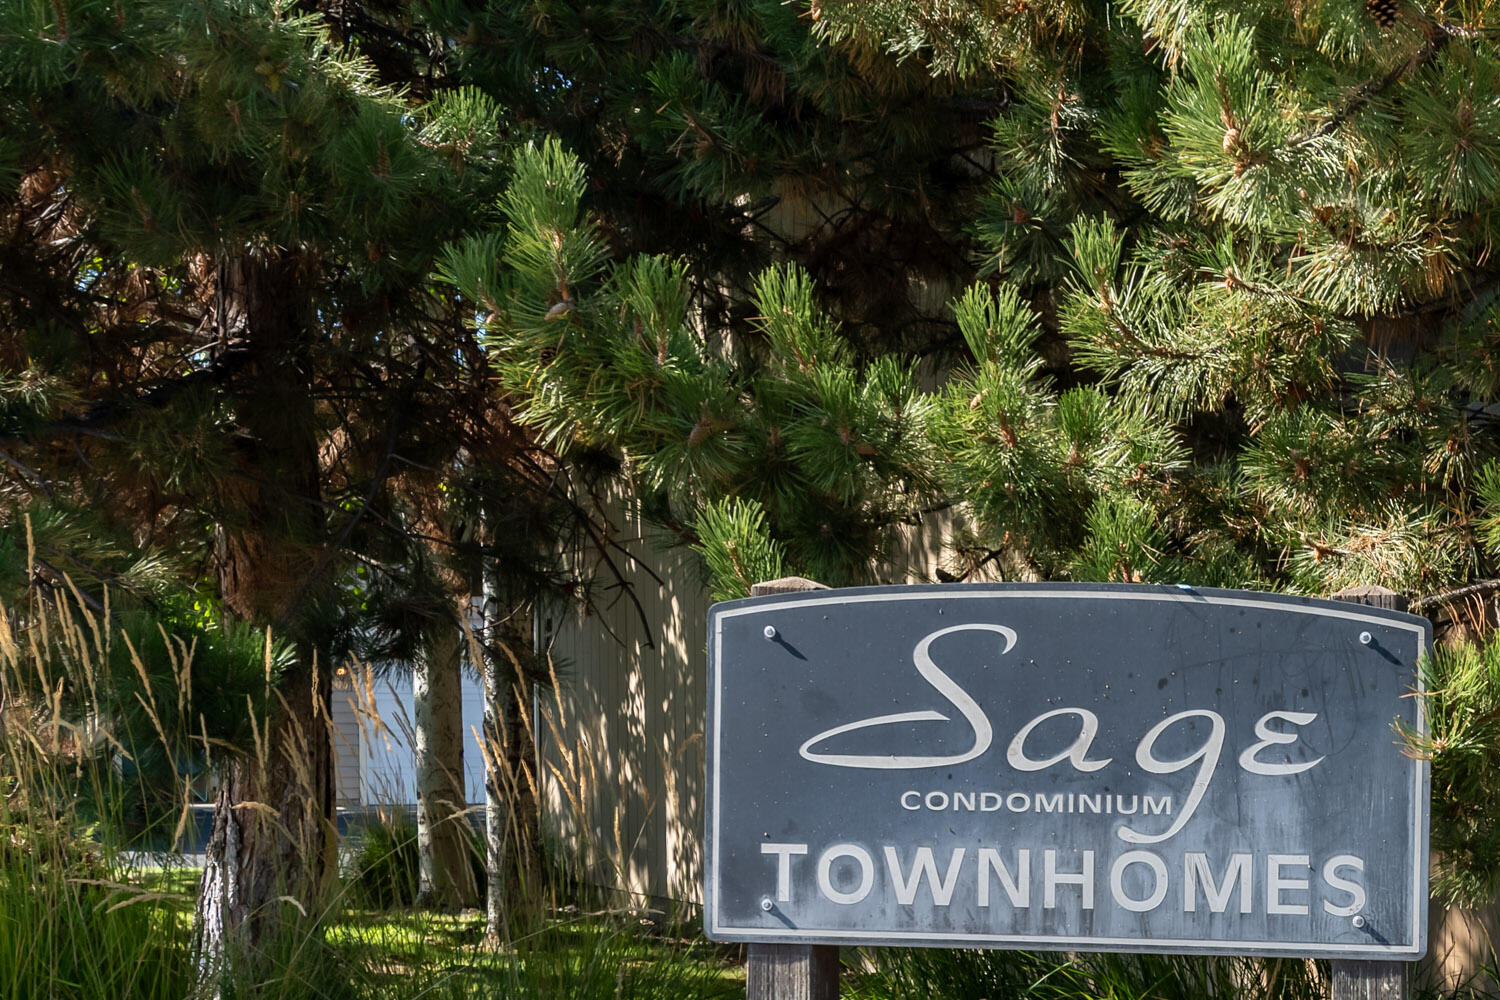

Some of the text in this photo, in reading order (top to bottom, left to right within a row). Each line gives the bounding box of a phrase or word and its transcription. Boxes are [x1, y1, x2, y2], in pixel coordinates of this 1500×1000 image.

[799, 622, 1326, 844] Sage
[899, 790, 1172, 815] CONDOMINIUM
[760, 842, 1368, 917] TOWNHOMES
